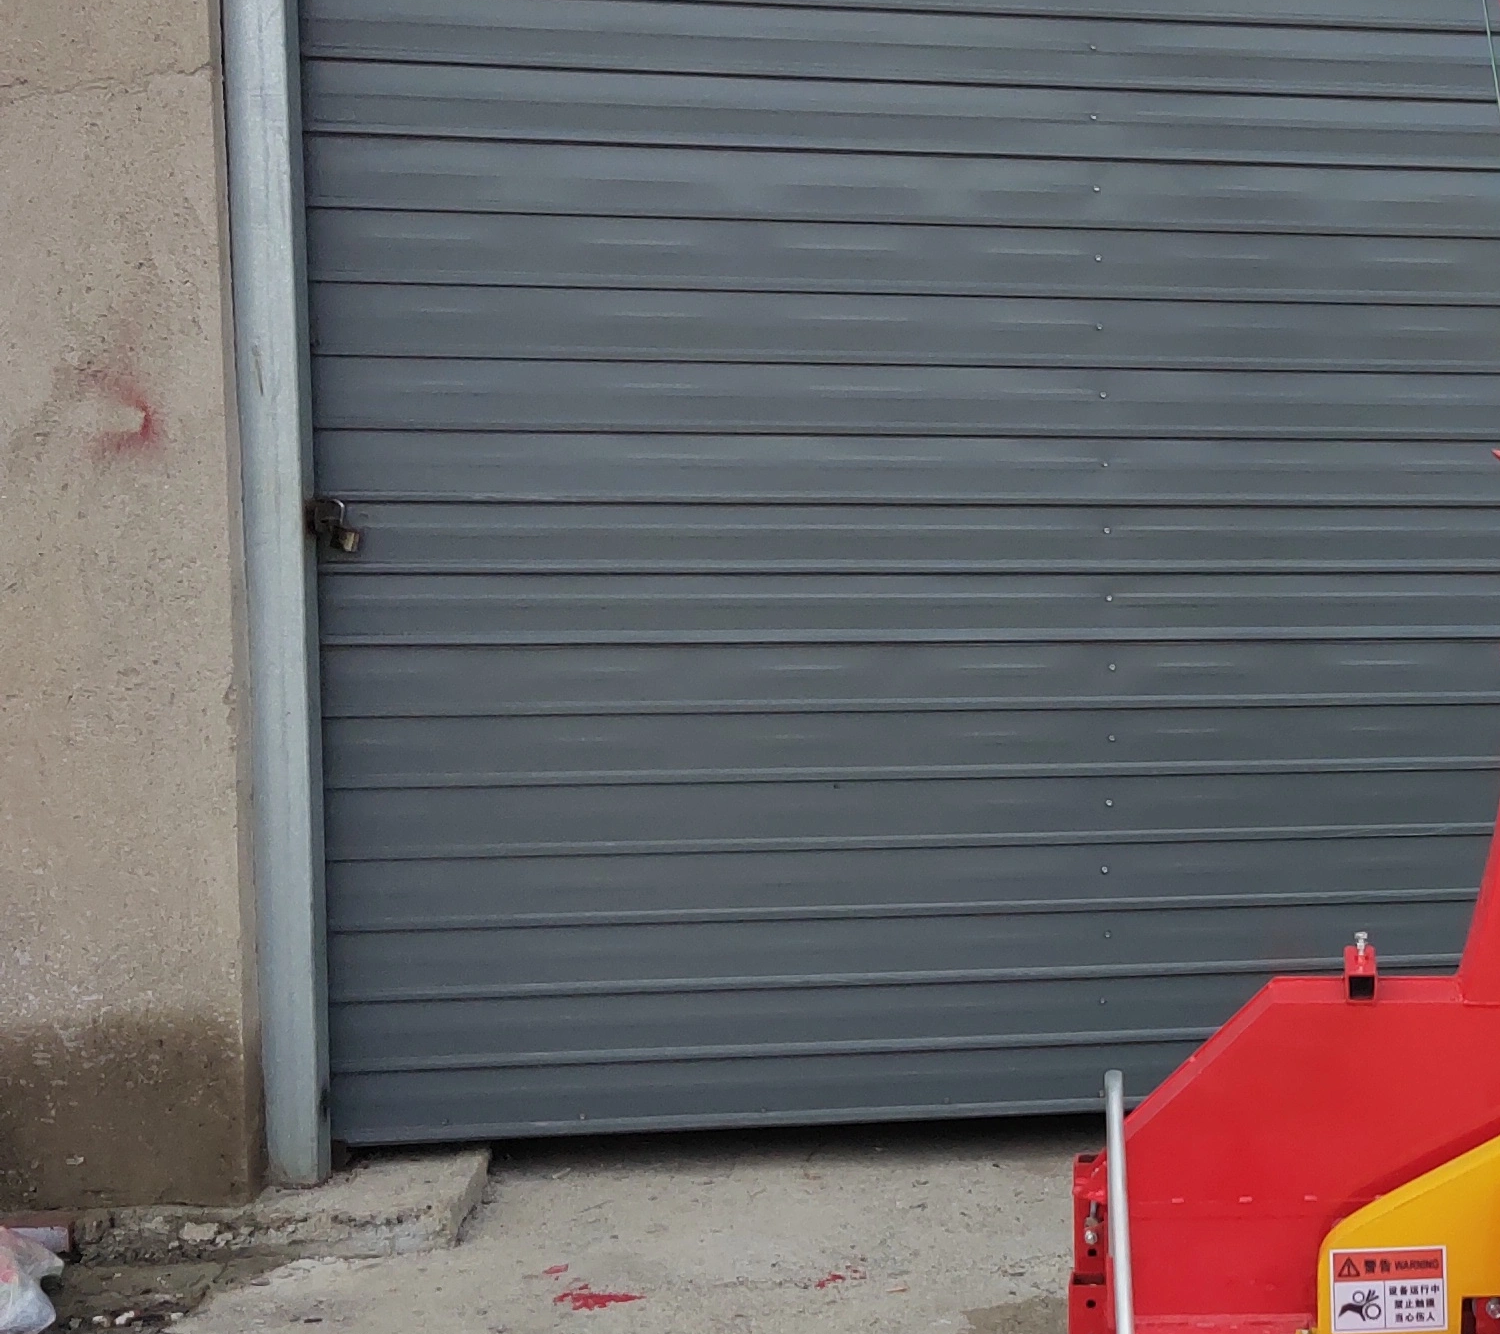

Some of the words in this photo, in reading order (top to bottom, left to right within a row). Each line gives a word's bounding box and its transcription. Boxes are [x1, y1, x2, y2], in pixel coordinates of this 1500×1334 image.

[1394, 1258, 1440, 1271] WARNING
[1388, 1284, 1440, 1296] 设备运行中
[1395, 1311, 1436, 1323] 当心伤人
